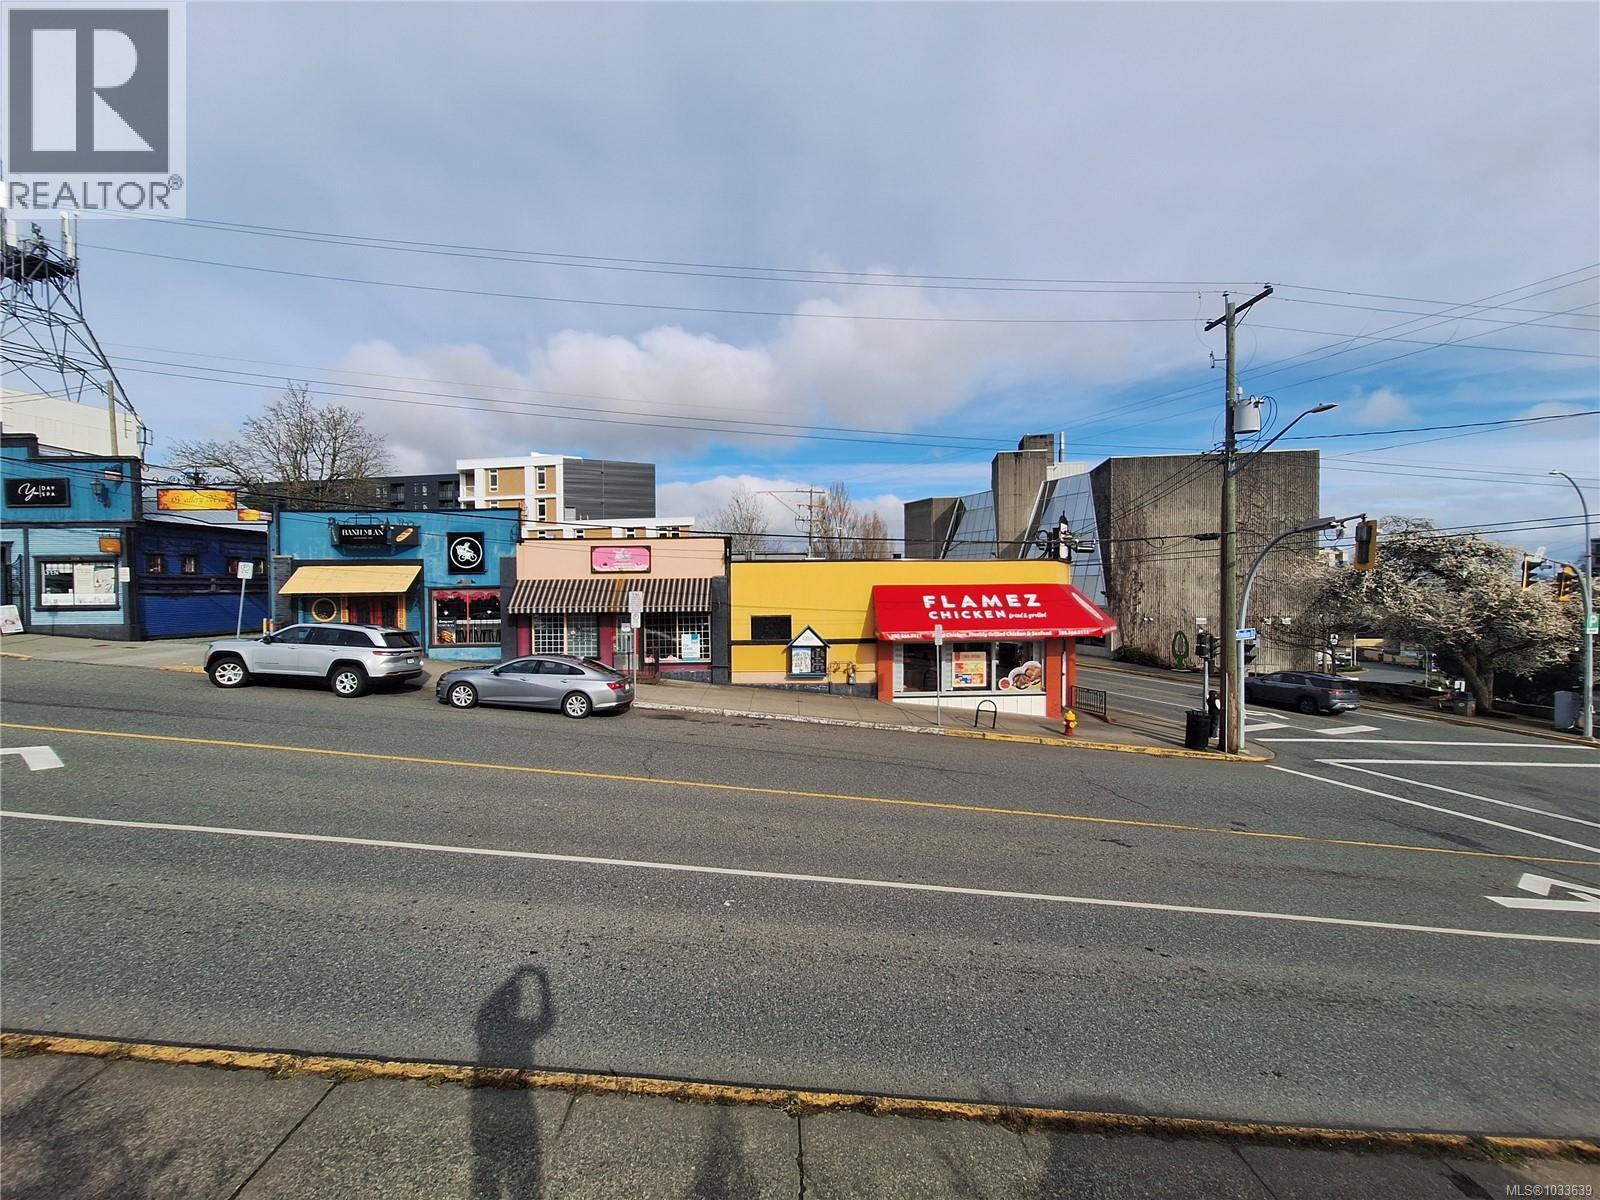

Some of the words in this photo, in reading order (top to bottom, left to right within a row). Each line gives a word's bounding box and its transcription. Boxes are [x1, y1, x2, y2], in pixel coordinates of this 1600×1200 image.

[922, 594, 1042, 609] FLAMEZ
[928, 610, 1007, 620] CHICKEN
[1589, 615, 1598, 627] P
